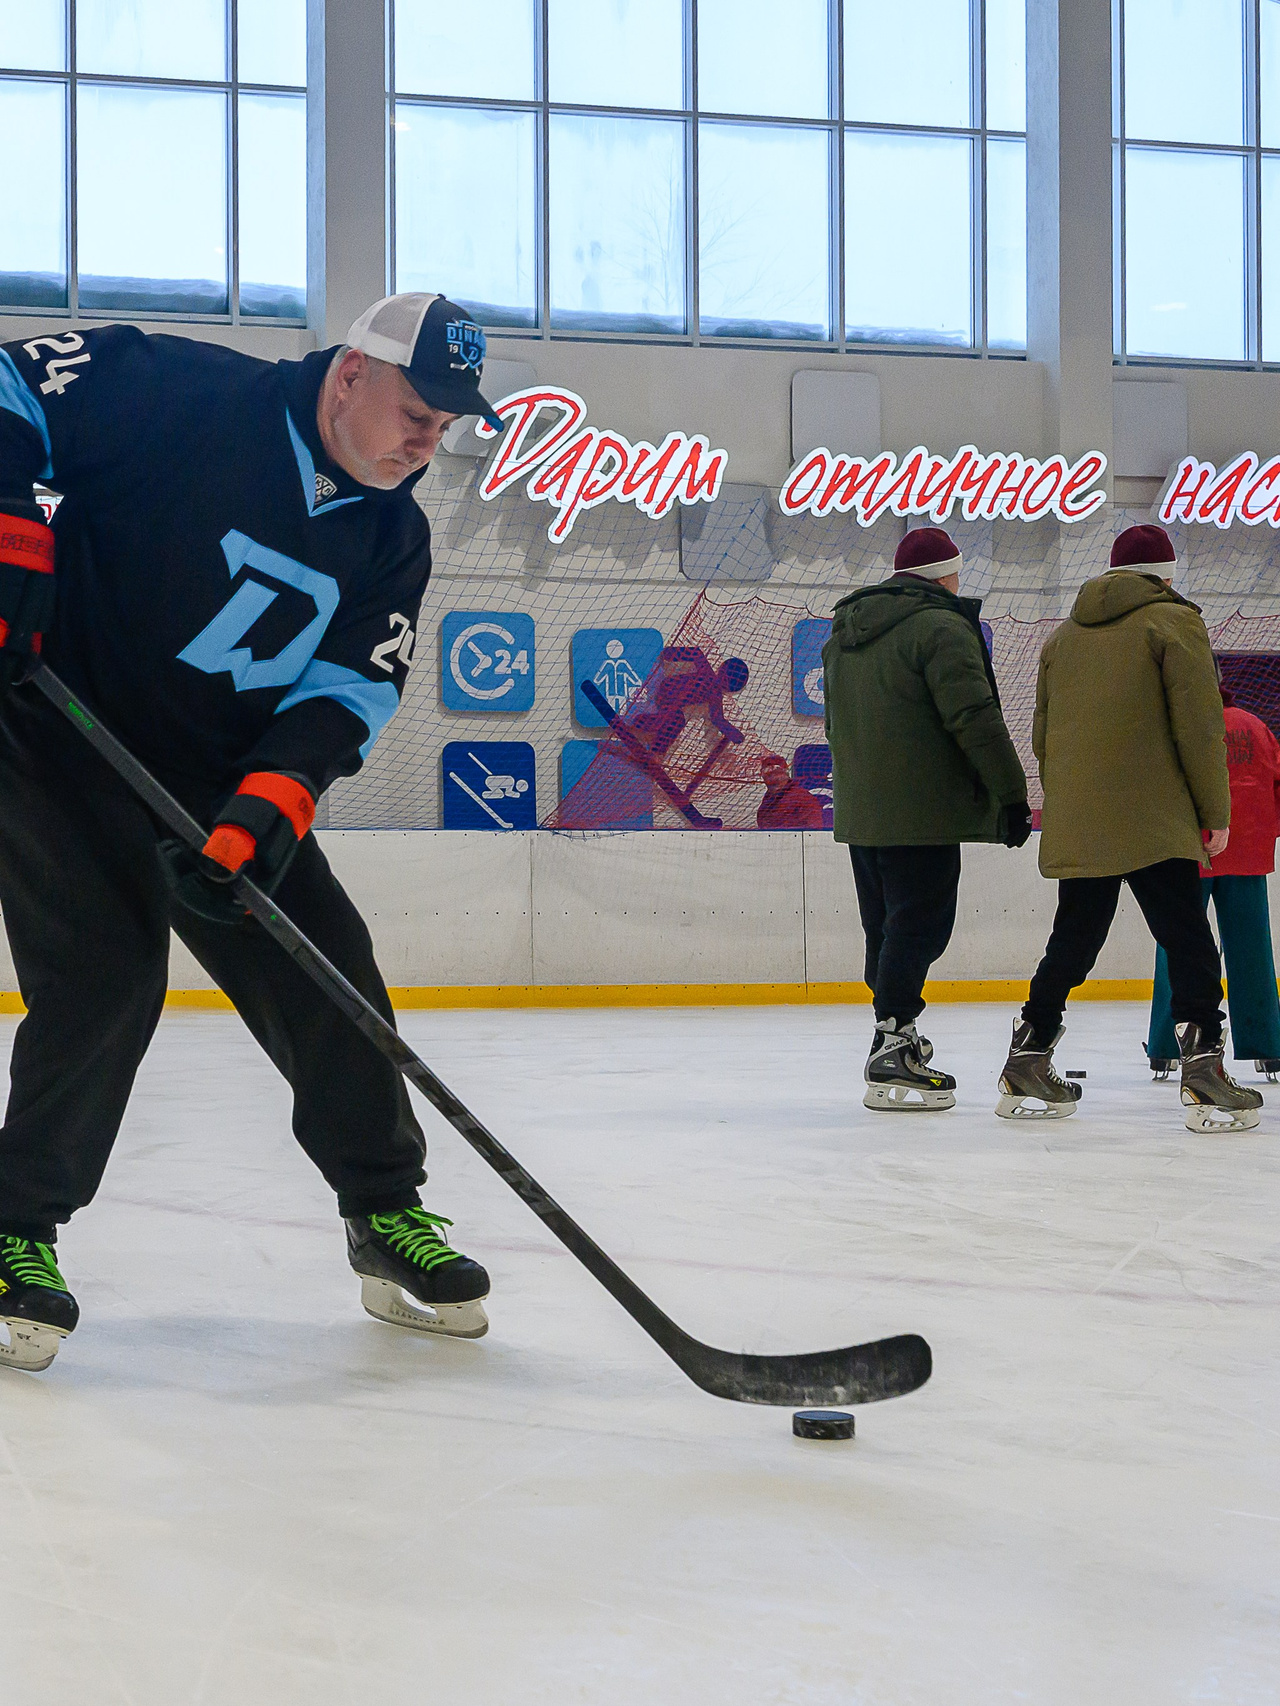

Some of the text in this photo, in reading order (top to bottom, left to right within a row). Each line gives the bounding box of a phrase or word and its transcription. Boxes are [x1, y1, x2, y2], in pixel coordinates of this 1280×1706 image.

[22, 331, 91, 395] 24
[448, 344, 459, 353] 19
[478, 390, 1280, 538] Дарим отличное нас
[494, 649, 530, 675] 24
